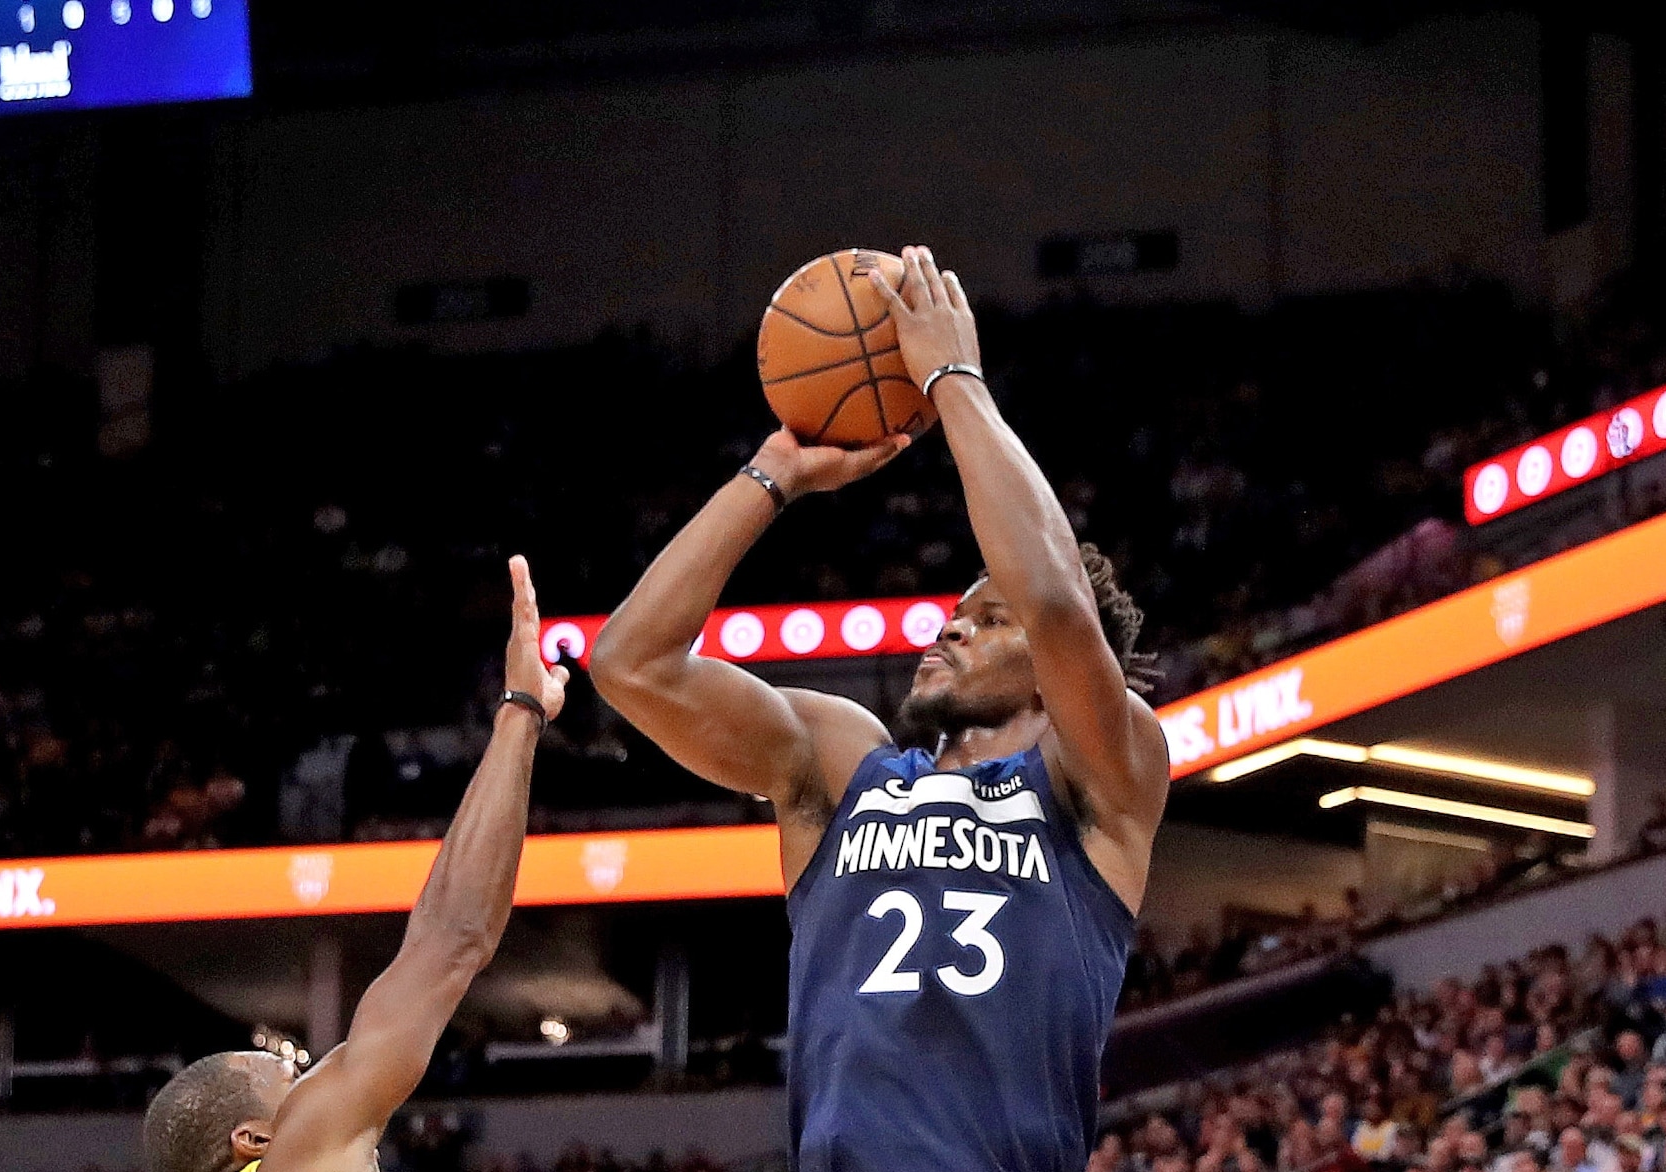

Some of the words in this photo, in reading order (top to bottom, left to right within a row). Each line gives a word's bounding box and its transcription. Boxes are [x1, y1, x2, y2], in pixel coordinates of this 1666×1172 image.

[1218, 667, 1314, 748] LYNX.
[981, 775, 1023, 798] fitbit
[835, 815, 1050, 883] MINNESOTA
[858, 889, 1007, 996] 23
